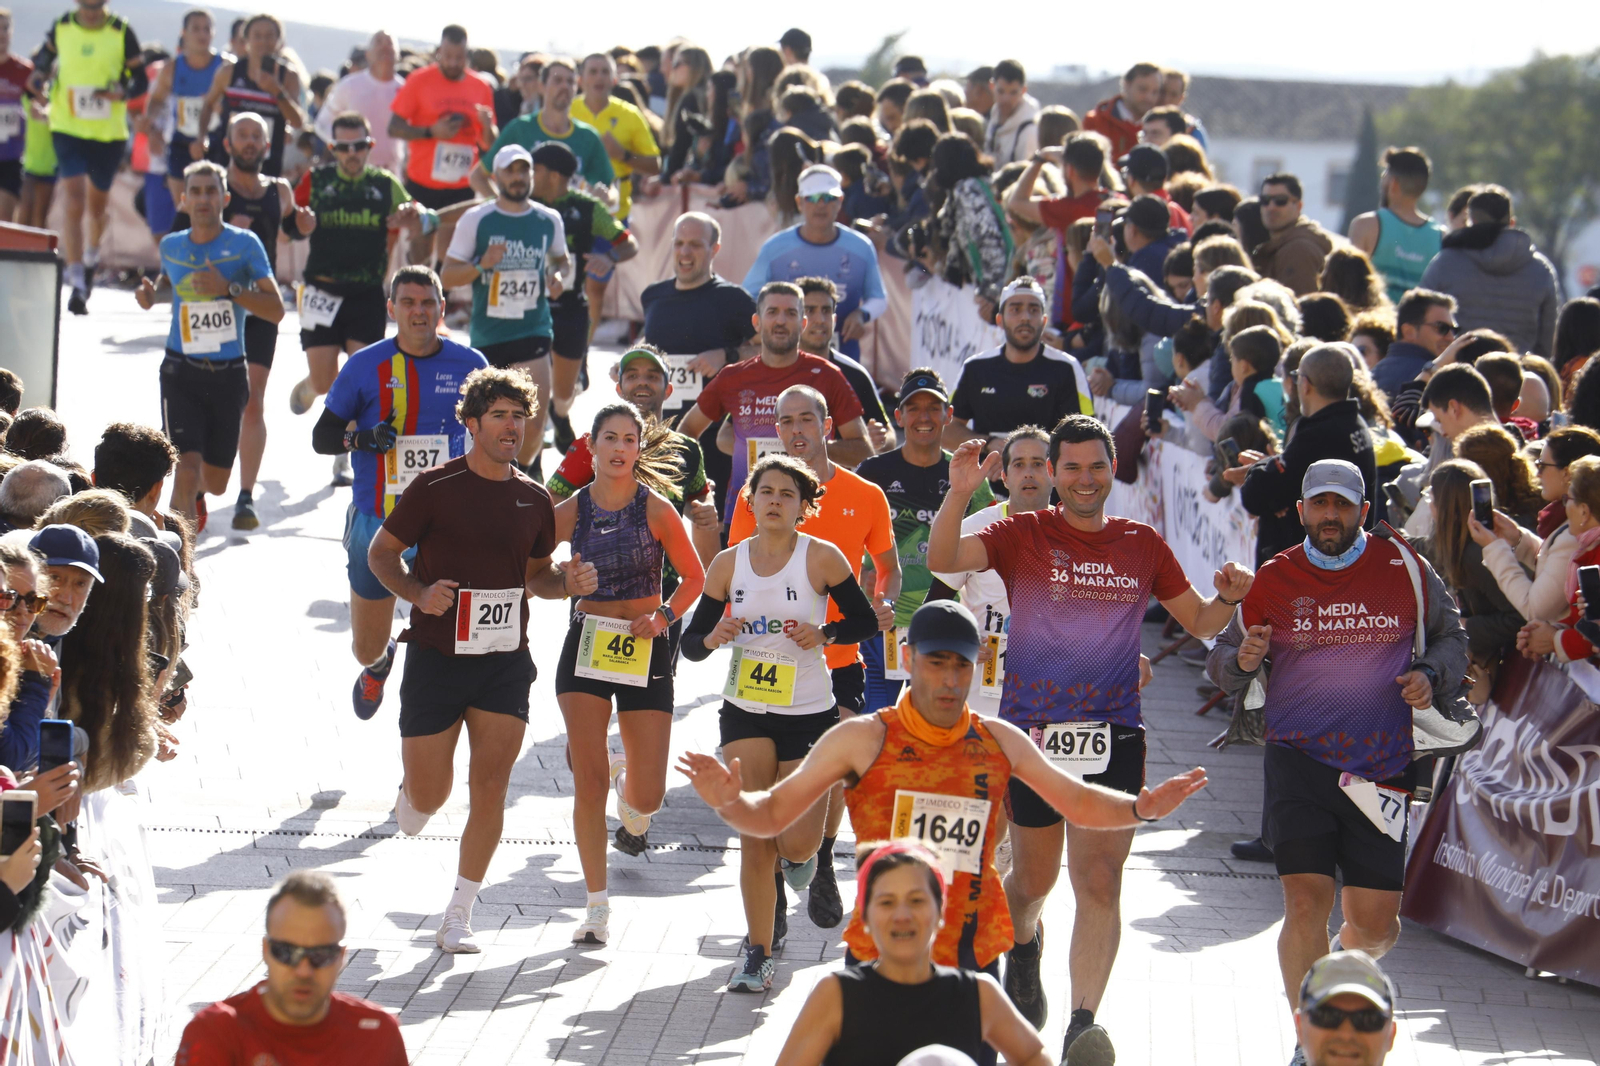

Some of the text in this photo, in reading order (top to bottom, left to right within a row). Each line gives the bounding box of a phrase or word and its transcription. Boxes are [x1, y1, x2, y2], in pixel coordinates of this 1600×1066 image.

[500, 281, 537, 297] 2347
[303, 294, 337, 313] 1624
[190, 310, 232, 329] 2406
[739, 405, 752, 416] 36
[404, 449, 440, 469] 837
[1073, 562, 1115, 575] MEDIA
[1050, 568, 1139, 589] 36 MARATÓN
[1121, 593, 1140, 602] 2022
[478, 602, 513, 625] 207
[1318, 603, 1369, 617] MEDIA
[735, 615, 799, 635] ndea
[1292, 612, 1400, 632] 36 MARATÓN
[607, 634, 636, 657] 46
[1317, 633, 1400, 645] CÓRDOBA 2022
[749, 649, 775, 659] IMDECO
[750, 662, 778, 687] 44
[1045, 731, 1107, 756] 4976
[925, 798, 962, 810] IMDECO
[914, 813, 981, 847] 1649
[1475, 851, 1540, 903] Municipal
[1549, 874, 1600, 922] Deport
